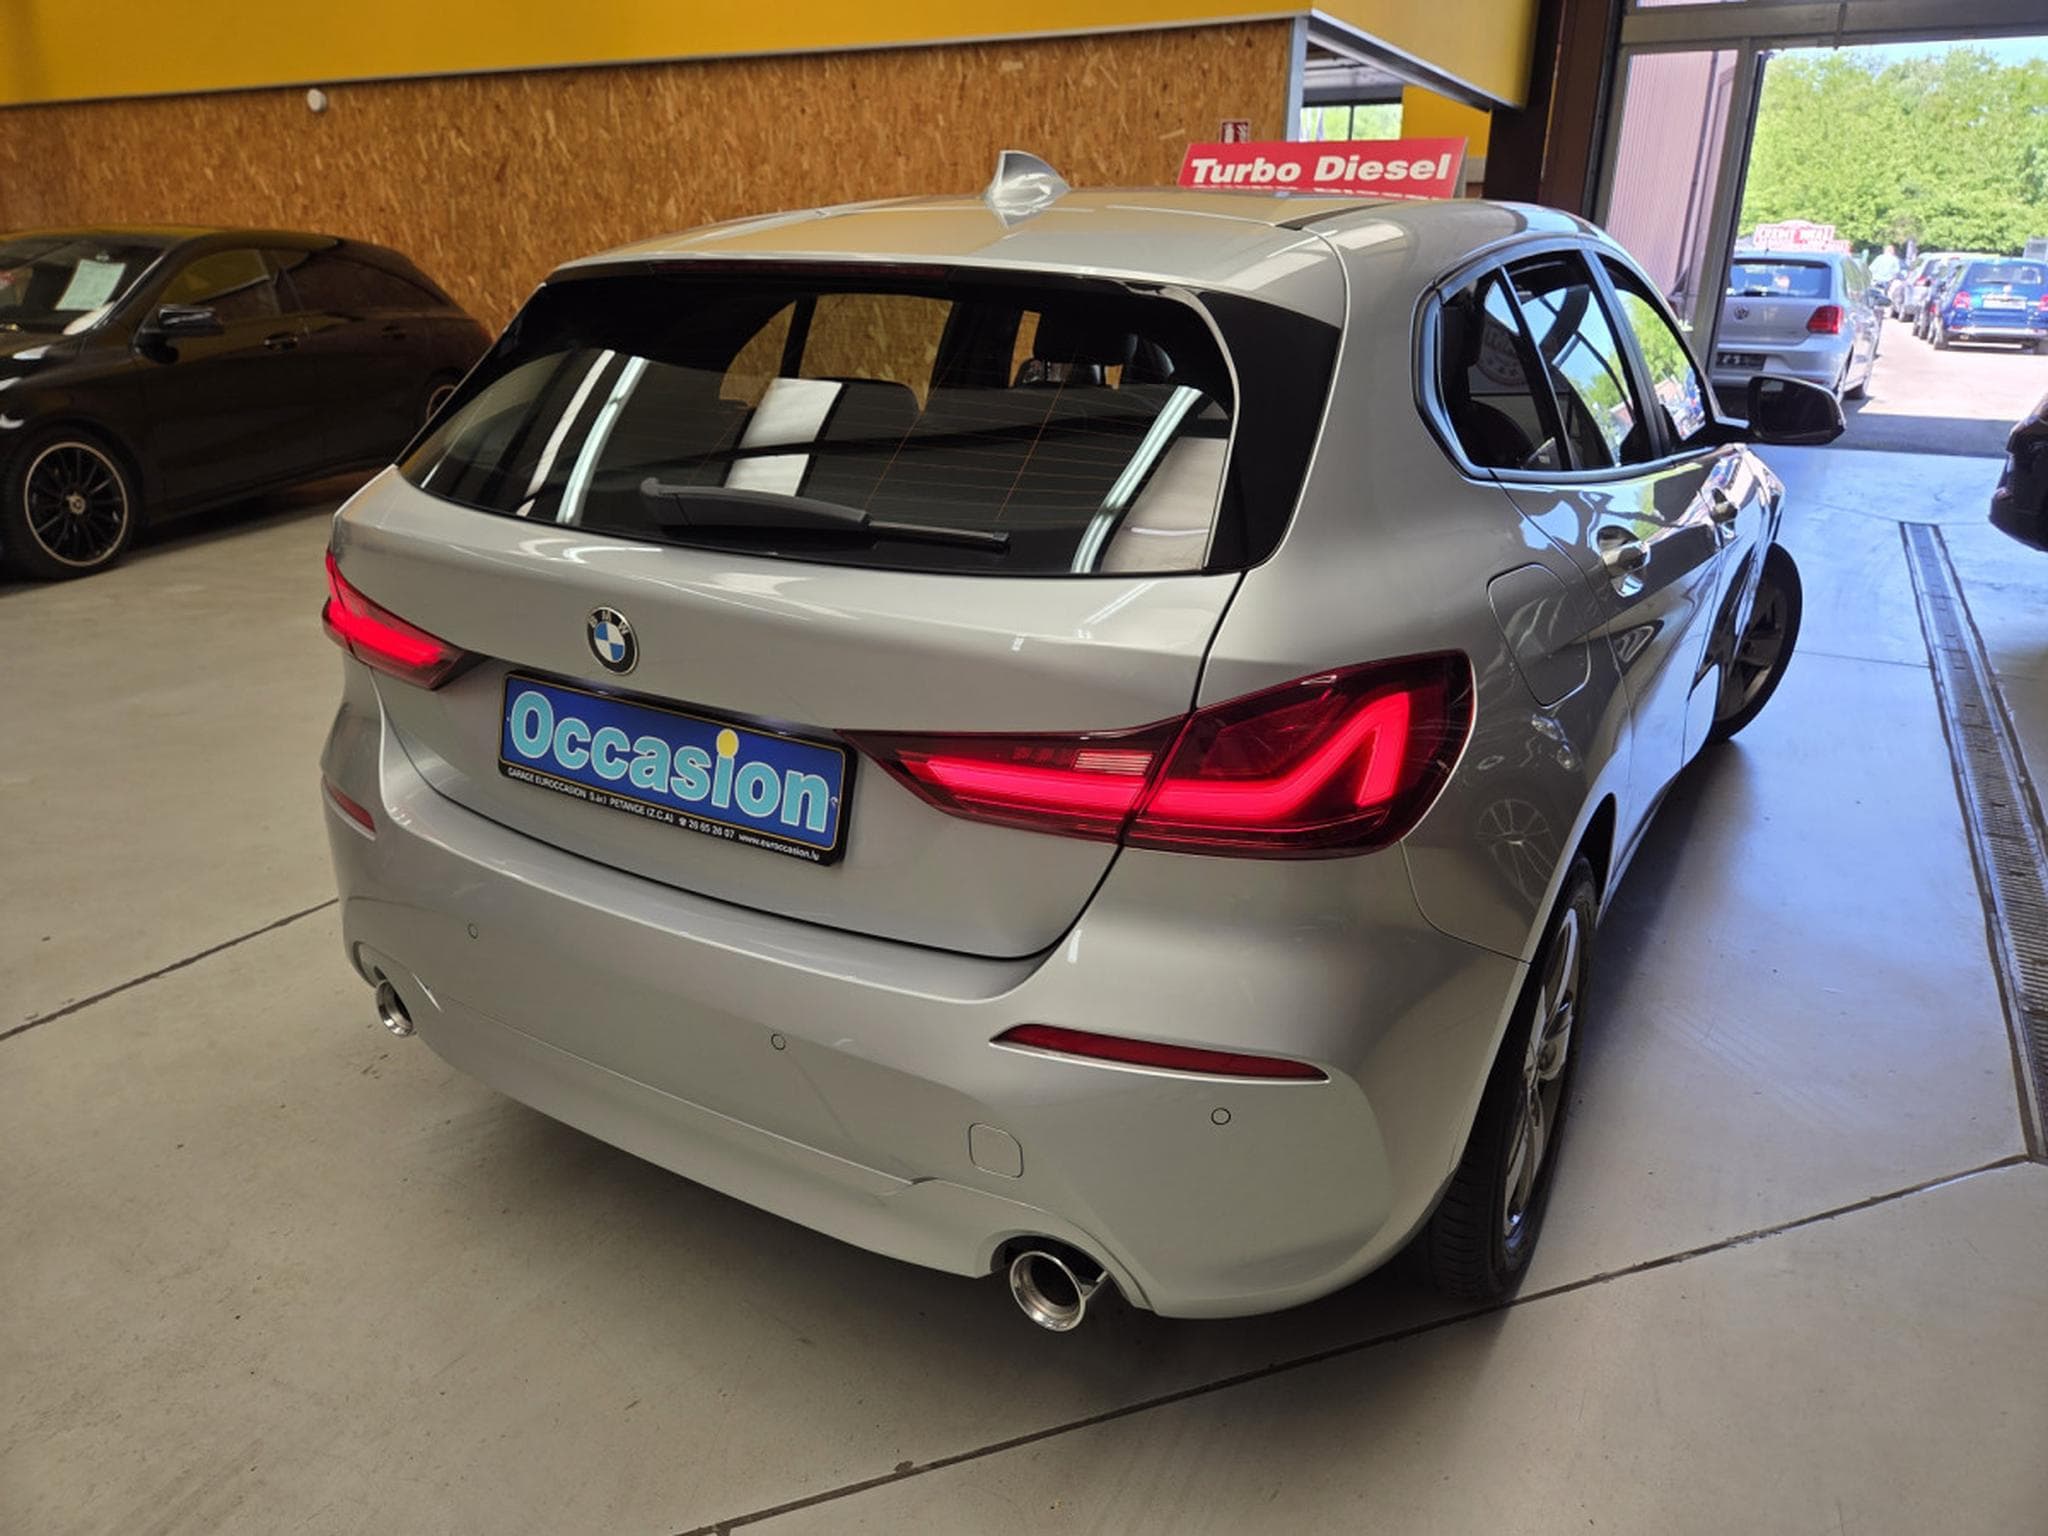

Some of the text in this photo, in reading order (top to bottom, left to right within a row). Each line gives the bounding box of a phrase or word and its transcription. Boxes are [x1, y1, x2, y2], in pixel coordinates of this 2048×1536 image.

[1191, 153, 1452, 183] Turbo Diesel
[510, 690, 830, 832] Occasion
[507, 766, 535, 783] GARAGE
[535, 774, 587, 799] EUROCCASION
